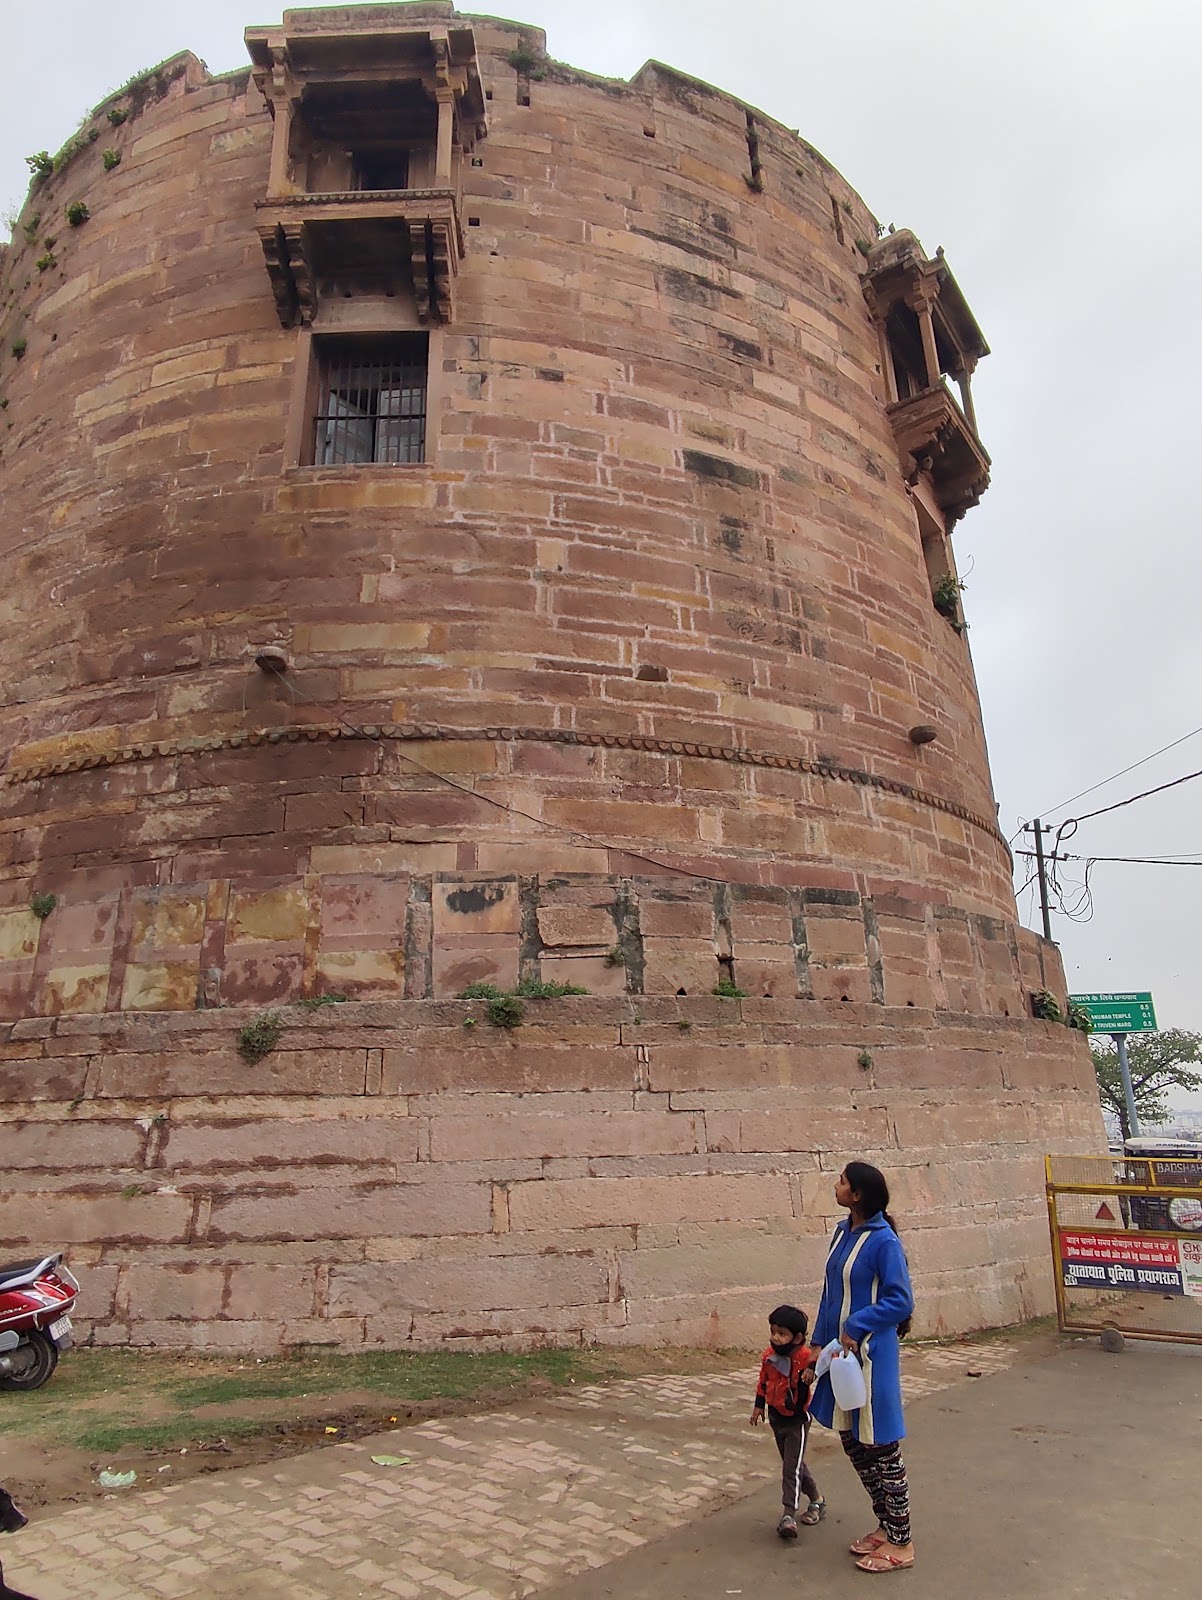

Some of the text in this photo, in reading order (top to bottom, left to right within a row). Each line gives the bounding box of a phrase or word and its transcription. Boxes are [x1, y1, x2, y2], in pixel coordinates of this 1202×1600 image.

[1068, 1264, 1180, 1286] यातायात पुलिस प्रयागराज
